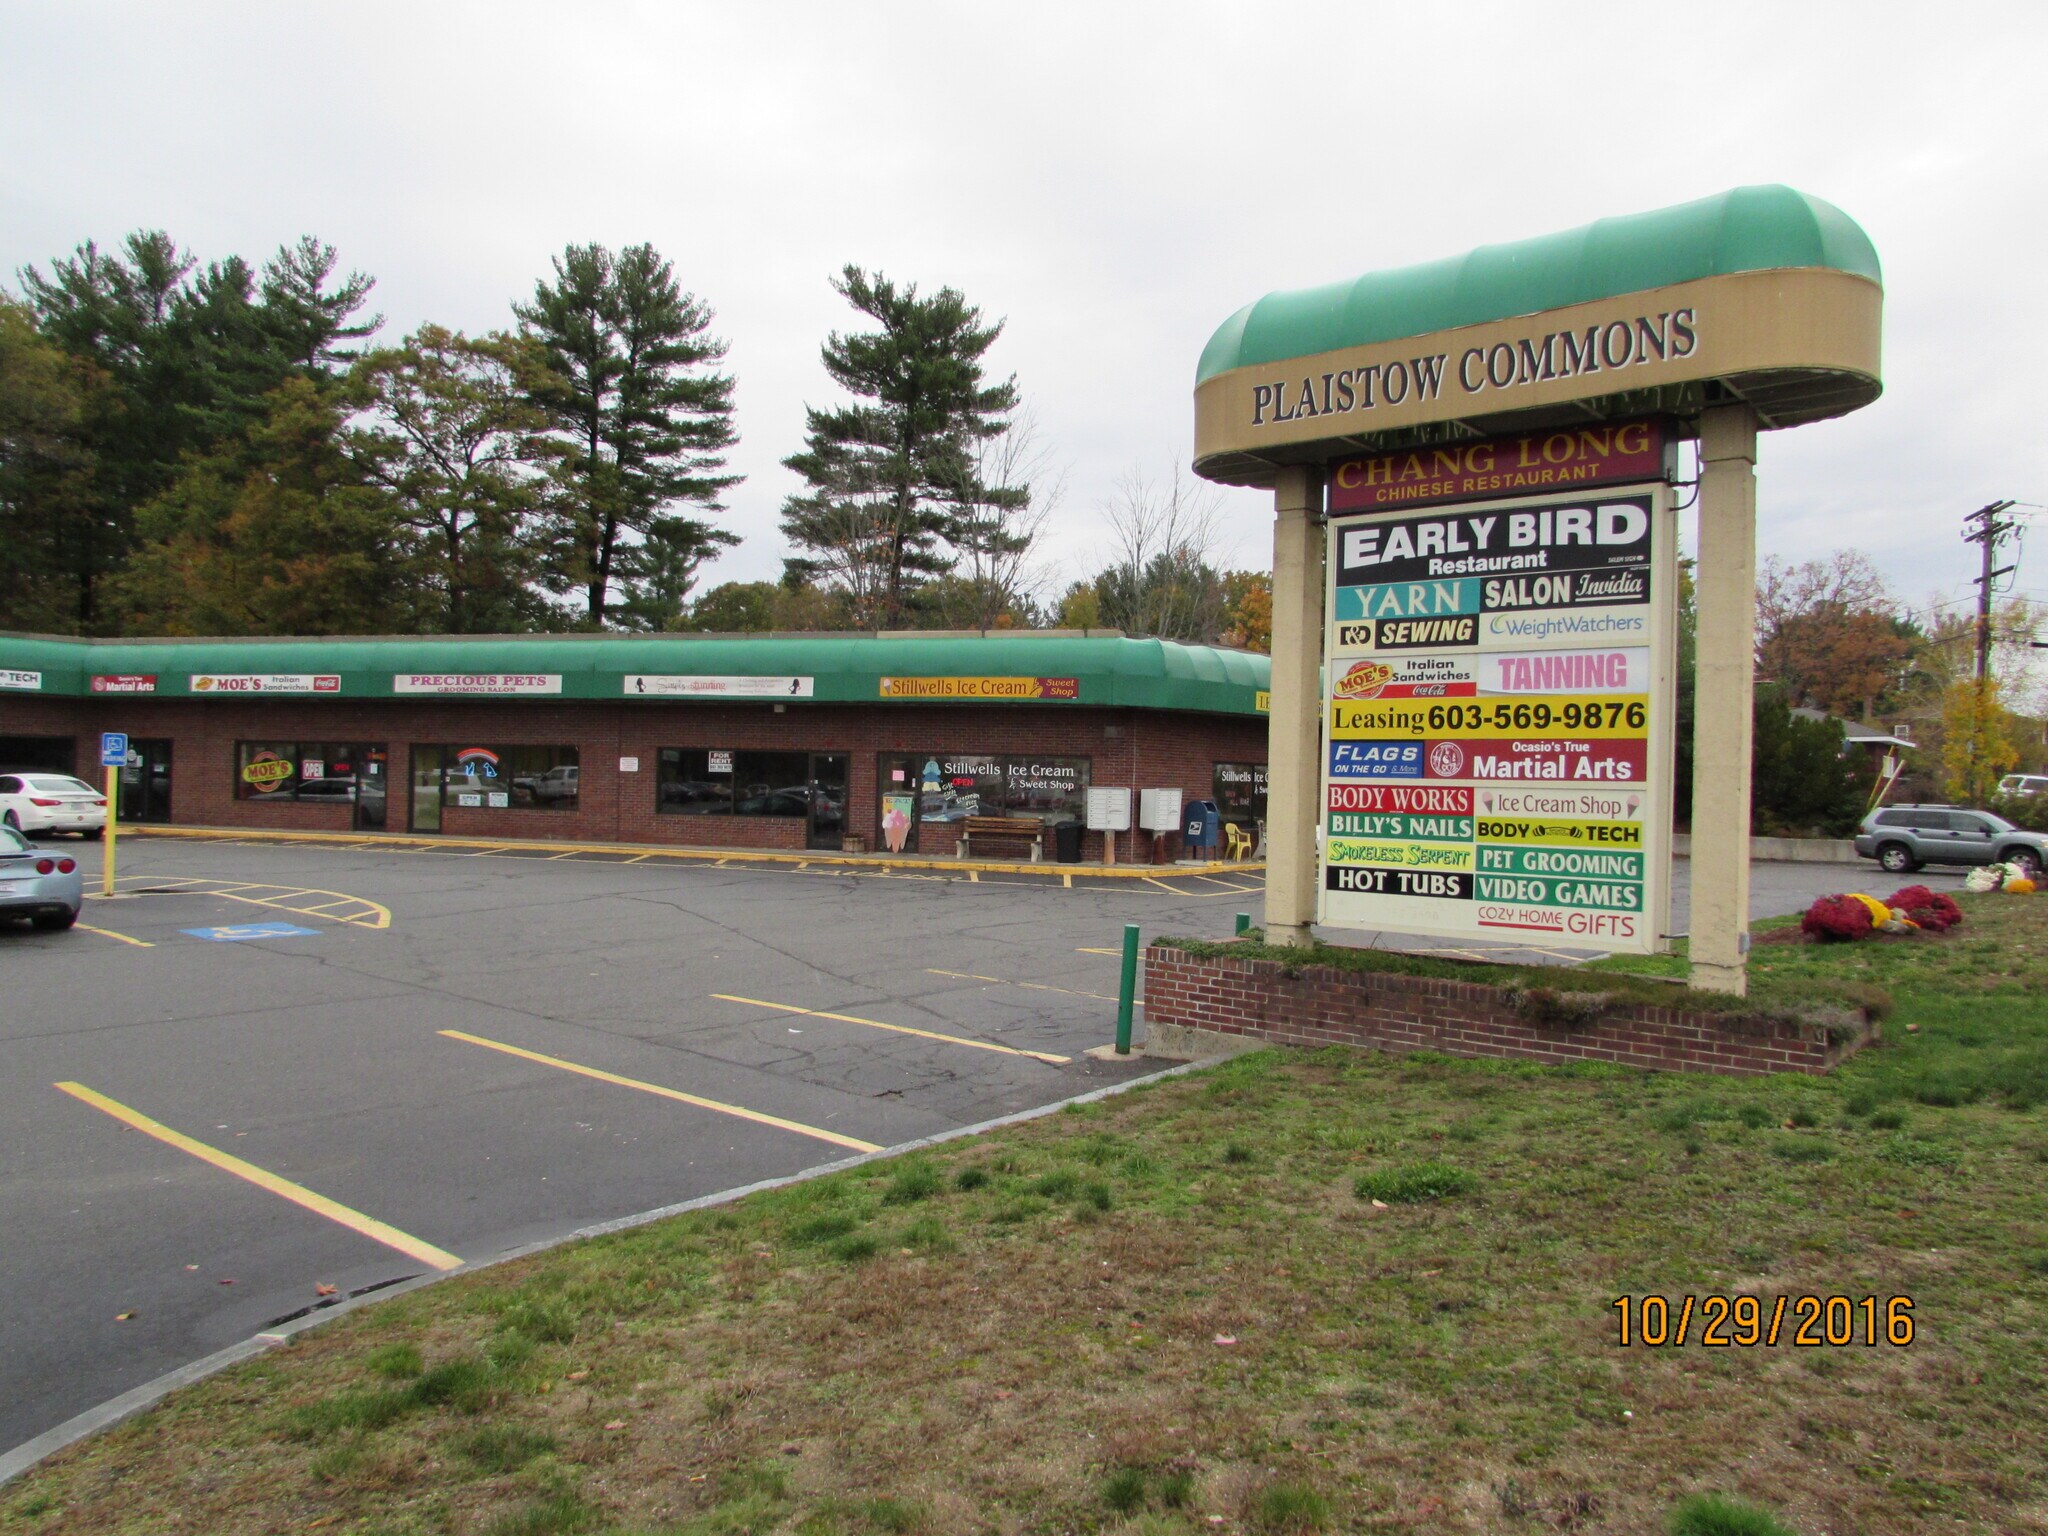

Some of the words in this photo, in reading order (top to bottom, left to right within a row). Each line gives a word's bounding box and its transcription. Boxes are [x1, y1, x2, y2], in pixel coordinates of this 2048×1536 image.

[1252, 354, 1448, 426] PLAISTOW
[1459, 308, 1698, 395] COMMONS
[1336, 444, 1495, 489] CHANG
[1517, 423, 1650, 469] LONG
[1376, 482, 1454, 502] CHINESE
[1463, 463, 1600, 492] RESTAURANT
[1343, 516, 1497, 569] EARLY
[1508, 504, 1648, 548] BIRD
[1428, 550, 1548, 576] Restaurant
[1354, 582, 1463, 618] YARN
[1485, 575, 1571, 608] SALON
[1575, 571, 1643, 596] Invidia
[1381, 619, 1473, 645] SEWING
[1505, 614, 1644, 639] WeightWatchers
[1392, 670, 1471, 682] Sandwiches
[1407, 659, 1455, 671] Italian
[1497, 653, 1627, 690] TANNING
[8, 672, 38, 682] TECH
[106, 681, 135, 691] Martial
[136, 682, 155, 691] Arts
[217, 677, 262, 690] MOE'S
[263, 683, 309, 691] Sandwiches
[410, 676, 497, 686] PRECIOUS
[503, 676, 546, 686] PETS
[892, 679, 953, 695] Stillwells
[957, 680, 977, 695] Ice
[981, 680, 1027, 695] Cream
[1045, 678, 1074, 687] Sweet
[1339, 665, 1390, 692] MOE'S
[1051, 687, 1074, 696] Shop
[1334, 707, 1425, 734] Leasing
[1428, 702, 1646, 731] 603-569-9876
[1335, 745, 1418, 761] FLAGS
[1512, 742, 1560, 753] Ocasio's
[1563, 741, 1590, 752] True
[248, 761, 290, 778] MOE'S
[305, 762, 323, 777] OPEN
[944, 762, 1001, 775] Stillwells
[1008, 764, 1027, 776] Ice
[1031, 765, 1075, 777] Cream
[1221, 770, 1252, 782] Stillwells
[1254, 772, 1264, 783] Ice
[1334, 765, 1349, 773] ON
[1351, 765, 1369, 773] THE
[1372, 765, 1387, 773] GO
[1473, 755, 1567, 779] Martial
[1573, 756, 1632, 779] Arts
[952, 778, 974, 787] OPEN
[1019, 779, 1048, 789] Sweet
[1050, 780, 1075, 790] Shop
[1330, 787, 1385, 809] BODY
[1391, 788, 1468, 811] WORKS
[1498, 794, 1520, 812] Ice
[1523, 795, 1576, 814] Cream
[1580, 796, 1621, 819] Shop
[1332, 815, 1402, 835] BILLY'S
[1409, 818, 1472, 838] NAILS
[1477, 822, 1530, 838] BODY
[1586, 826, 1639, 842] TECH
[1330, 841, 1404, 862] SMOKELESS
[1406, 844, 1471, 867] SERPENT
[1482, 849, 1514, 869] PET
[1522, 852, 1637, 876] GROOMING
[1338, 869, 1388, 891] HOT
[1397, 872, 1460, 896] TUBS
[1478, 878, 1547, 902] VIDEO
[1555, 882, 1638, 908] GAMES
[1478, 906, 1514, 920] COZY
[1518, 909, 1563, 925] HOME
[1567, 912, 1635, 937] GIFTS
